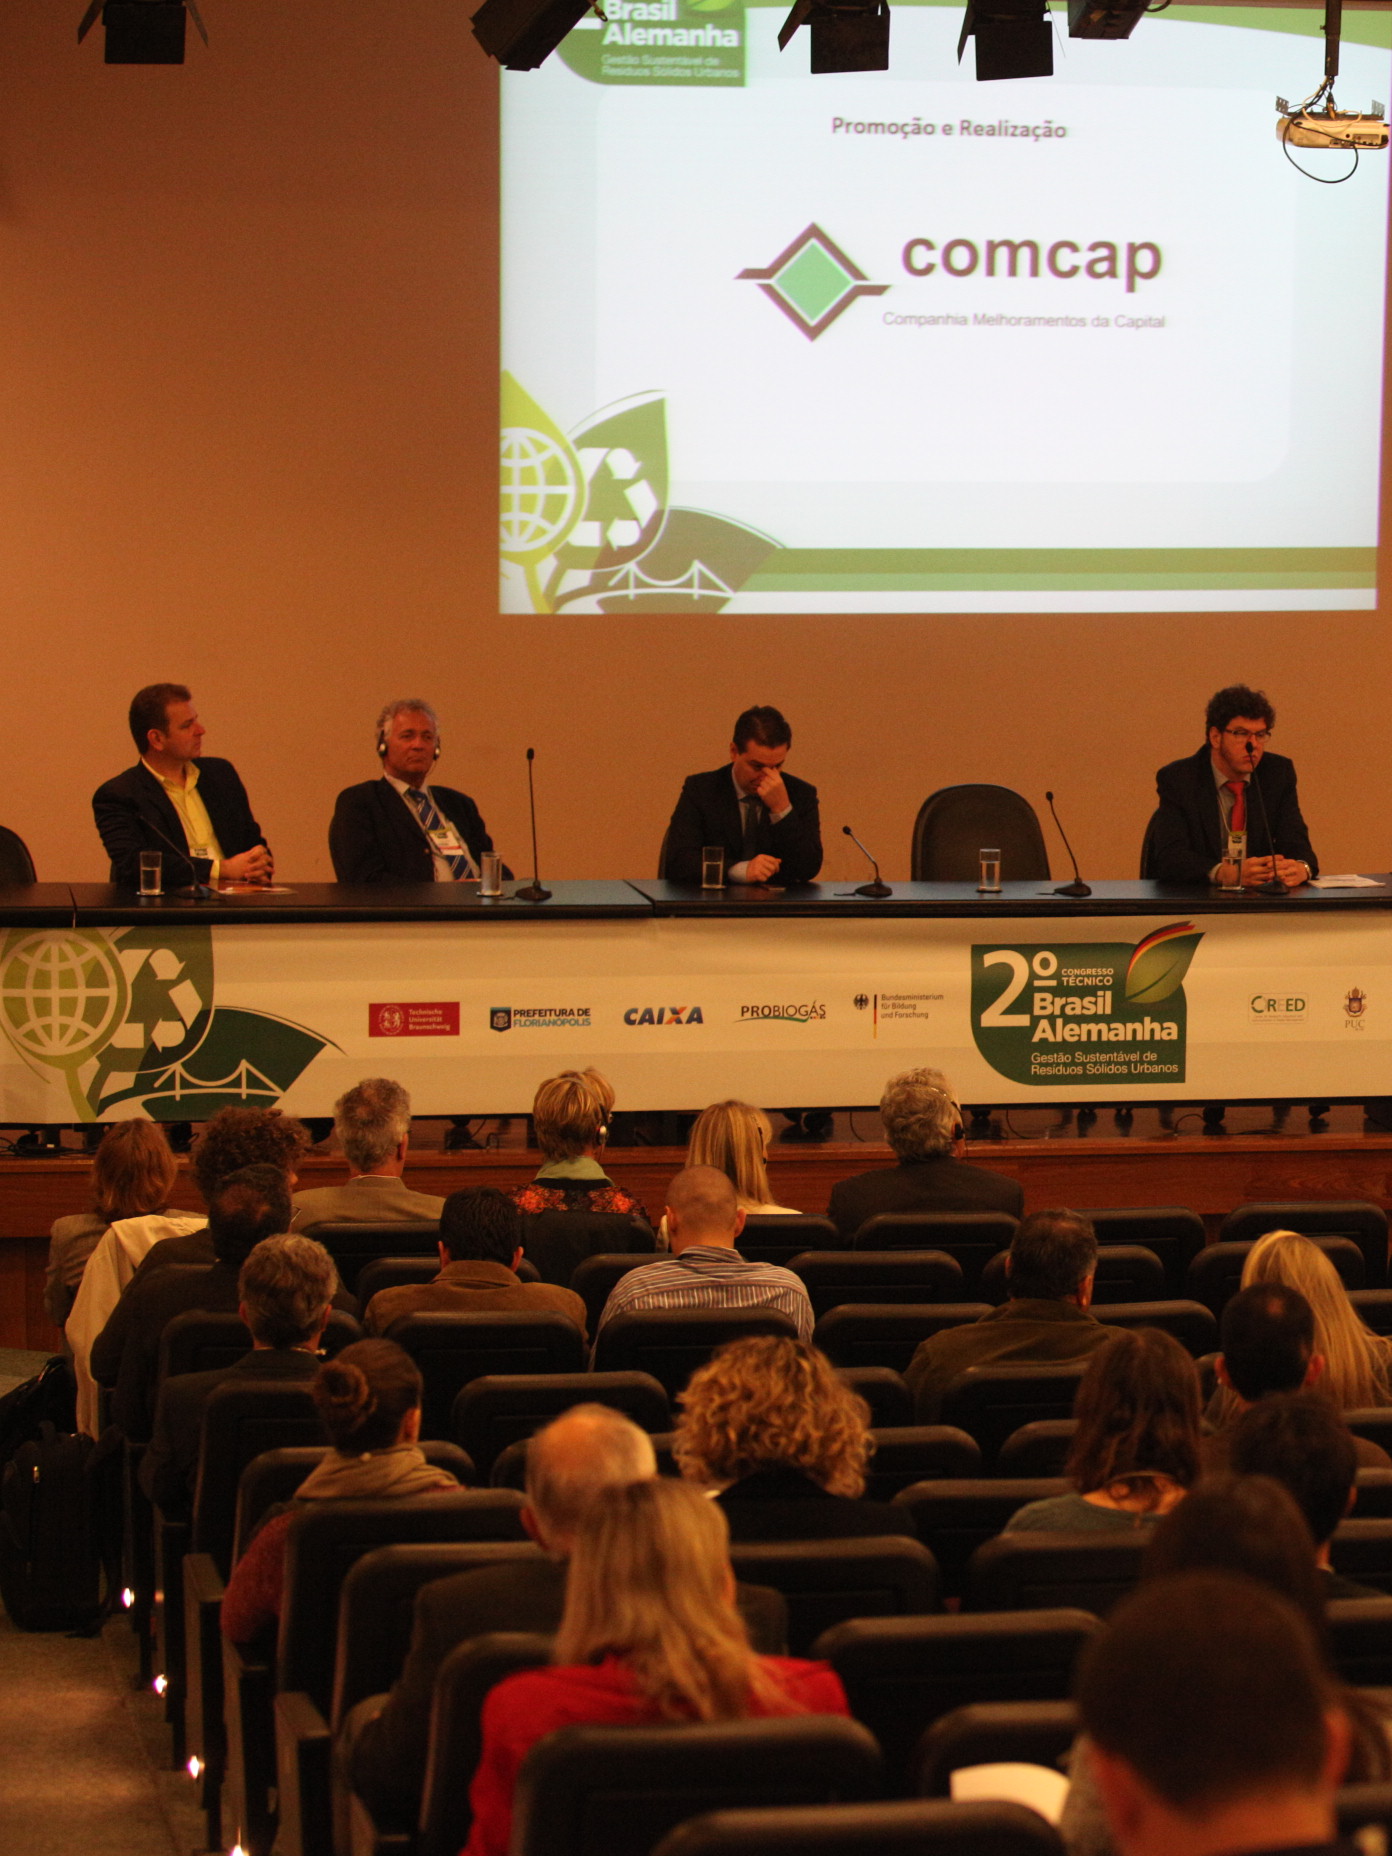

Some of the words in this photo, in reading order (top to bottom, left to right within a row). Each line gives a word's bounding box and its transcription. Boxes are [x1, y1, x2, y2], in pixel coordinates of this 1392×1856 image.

[603, 0, 678, 20] Brasil
[602, 23, 740, 47] Alemanha
[832, 117, 936, 139] Promoção
[942, 123, 953, 136] e
[960, 119, 1068, 142] Realização
[902, 237, 1163, 294] comcap
[883, 311, 968, 328] Companhia
[973, 313, 1087, 328] Melhoramentos
[1091, 315, 1110, 328] da
[1114, 315, 1166, 330] Capital
[1061, 968, 1114, 976] CONGRESSO
[1061, 975, 1113, 986] TÉCNICO
[881, 993, 944, 1001] Bundesministerium
[1033, 991, 1112, 1016] Brasil
[513, 1008, 575, 1018] PREFEITURA
[577, 1008, 591, 1017] DE
[741, 1000, 826, 1018] PROBIOGÁS
[881, 1002, 891, 1010] für
[892, 1002, 917, 1011] Bildung
[623, 1006, 704, 1026] CAIXA
[881, 1011, 893, 1019] und
[894, 1010, 929, 1020] Forschung
[513, 1016, 591, 1028] FLORIANÓPOLIS
[1345, 1019, 1365, 1029] PUC
[1031, 1017, 1179, 1042] Alemanha
[1031, 1052, 1072, 1063] Gestão
[1074, 1051, 1139, 1063] Sustentável
[1142, 1051, 1158, 1061] de
[1031, 1063, 1083, 1075] Resíduos
[1086, 1063, 1128, 1074] Sólidos
[1131, 1062, 1179, 1073] Urbanos
